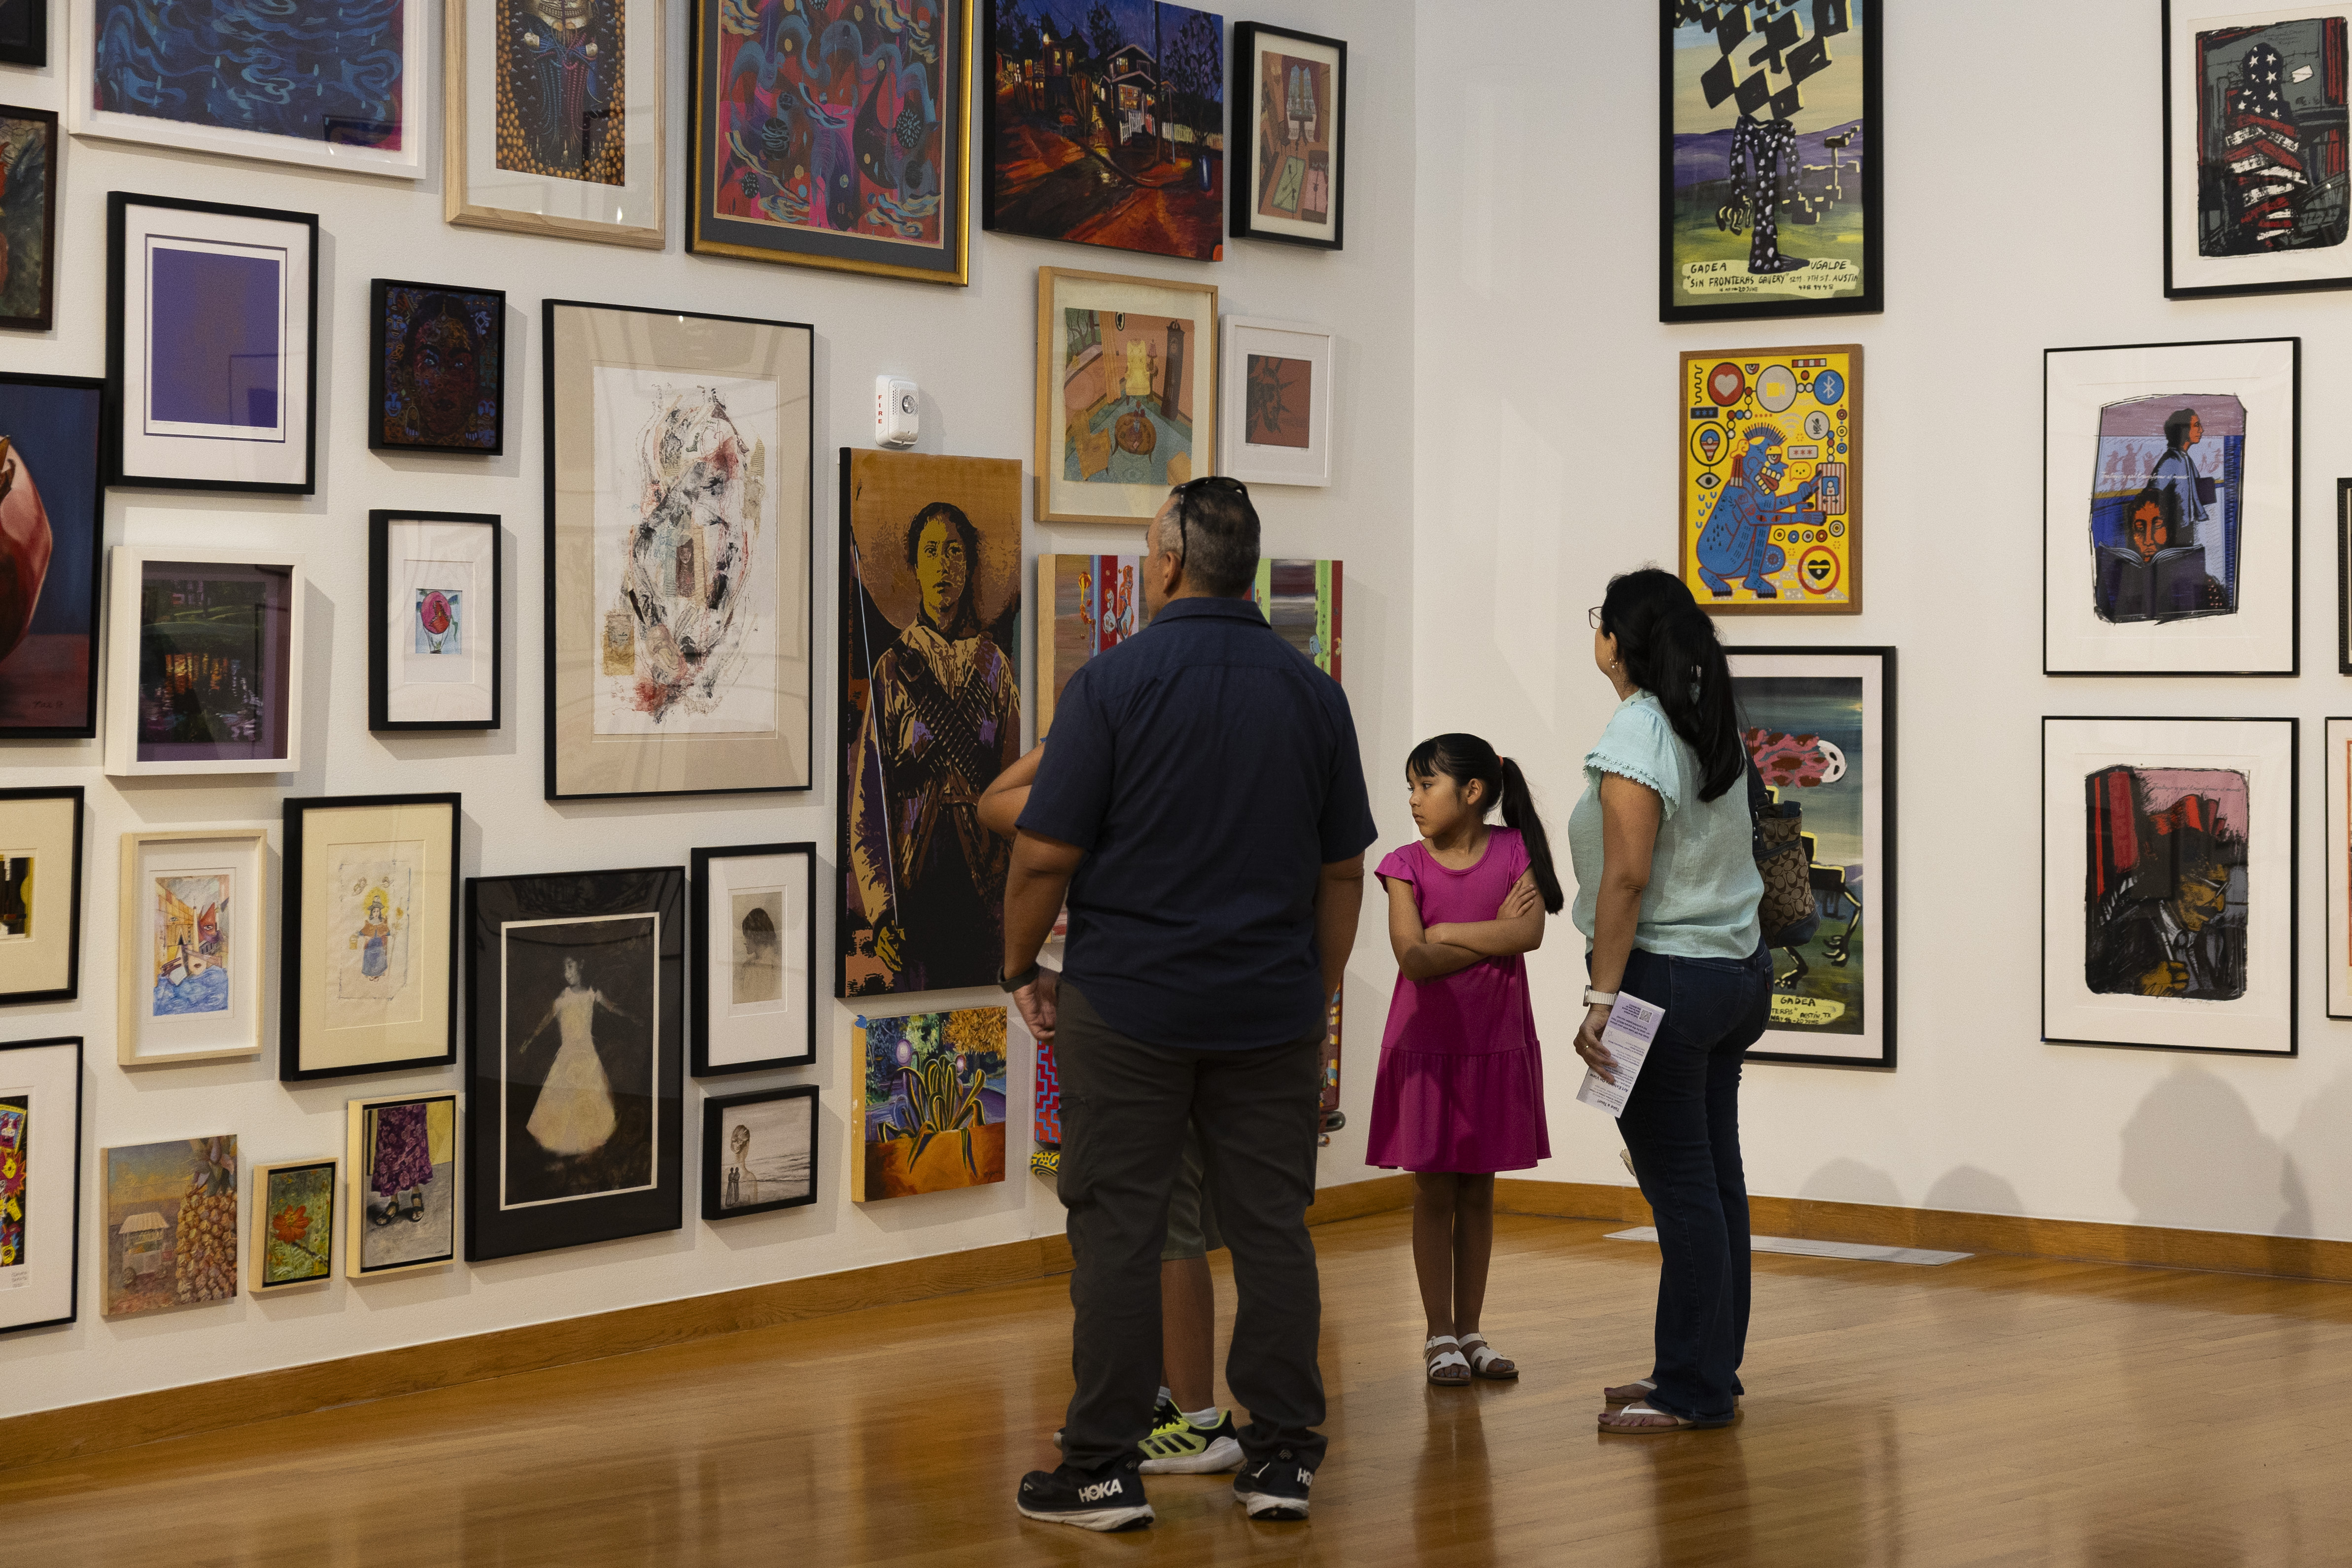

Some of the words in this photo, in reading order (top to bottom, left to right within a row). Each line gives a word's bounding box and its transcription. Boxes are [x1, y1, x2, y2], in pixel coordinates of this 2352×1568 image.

[1691, 263, 1727, 274] GADEA
[1811, 261, 1847, 270] UGALDE
[1709, 276, 1754, 287] FRONTERAS
[1780, 997, 1816, 1007] GADEA
[1297, 1467, 1314, 1486] HO
[1078, 1478, 1123, 1502] HOKA
